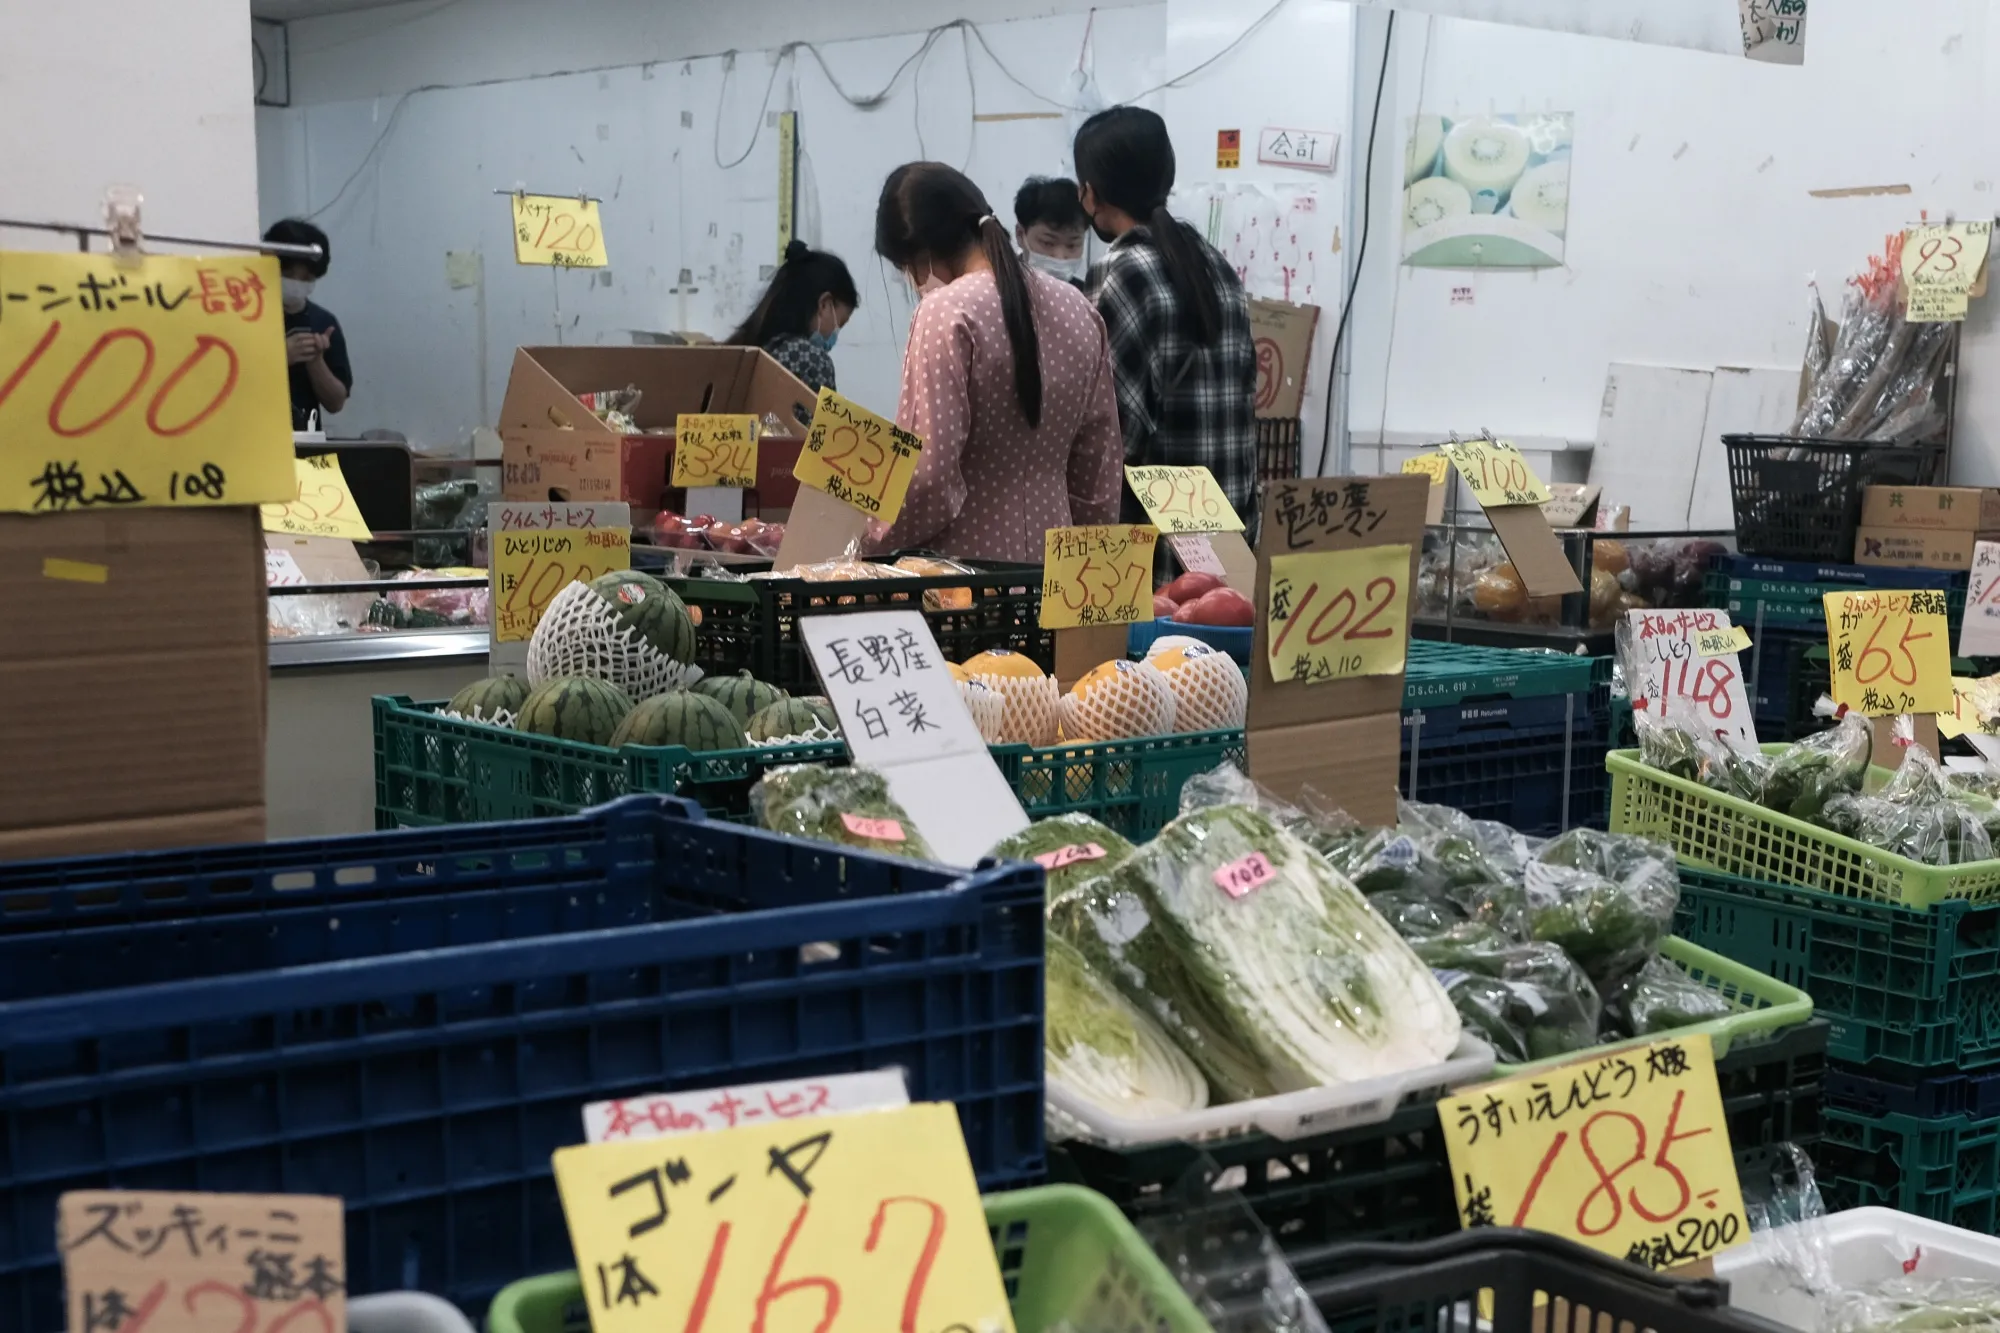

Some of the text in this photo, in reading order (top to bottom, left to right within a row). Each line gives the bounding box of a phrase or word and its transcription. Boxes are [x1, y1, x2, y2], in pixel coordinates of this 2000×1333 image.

[1269, 131, 1319, 161] 会計
[534, 213, 596, 252] 120
[1912, 236, 1963, 276] 93
[0, 267, 268, 323] ーンボール 長野
[0, 318, 241, 438] 100
[822, 395, 882, 439] 紅ハッサク
[169, 461, 226, 499] 108
[686, 443, 752, 478] 324
[821, 425, 900, 501] 231
[1478, 456, 1528, 492] 100
[501, 504, 598, 532] タイムサービス
[1147, 479, 1220, 518] 296
[505, 535, 572, 556] ひとりじめ
[1053, 538, 1131, 562] イエローキング
[1062, 557, 1147, 610] 537
[1271, 576, 1396, 657] 102
[1638, 610, 1721, 642] 本日のサービス
[1840, 611, 1863, 630] カブ
[825, 627, 932, 685] 長野産
[1855, 615, 1933, 686] 65
[855, 690, 942, 740] 白菜
[1229, 856, 1266, 886] 108
[1457, 1044, 1692, 1145] うすいえんどう 大阪
[607, 1129, 835, 1240] ゴーヤ
[67, 1200, 303, 1258] ズッキィーニ
